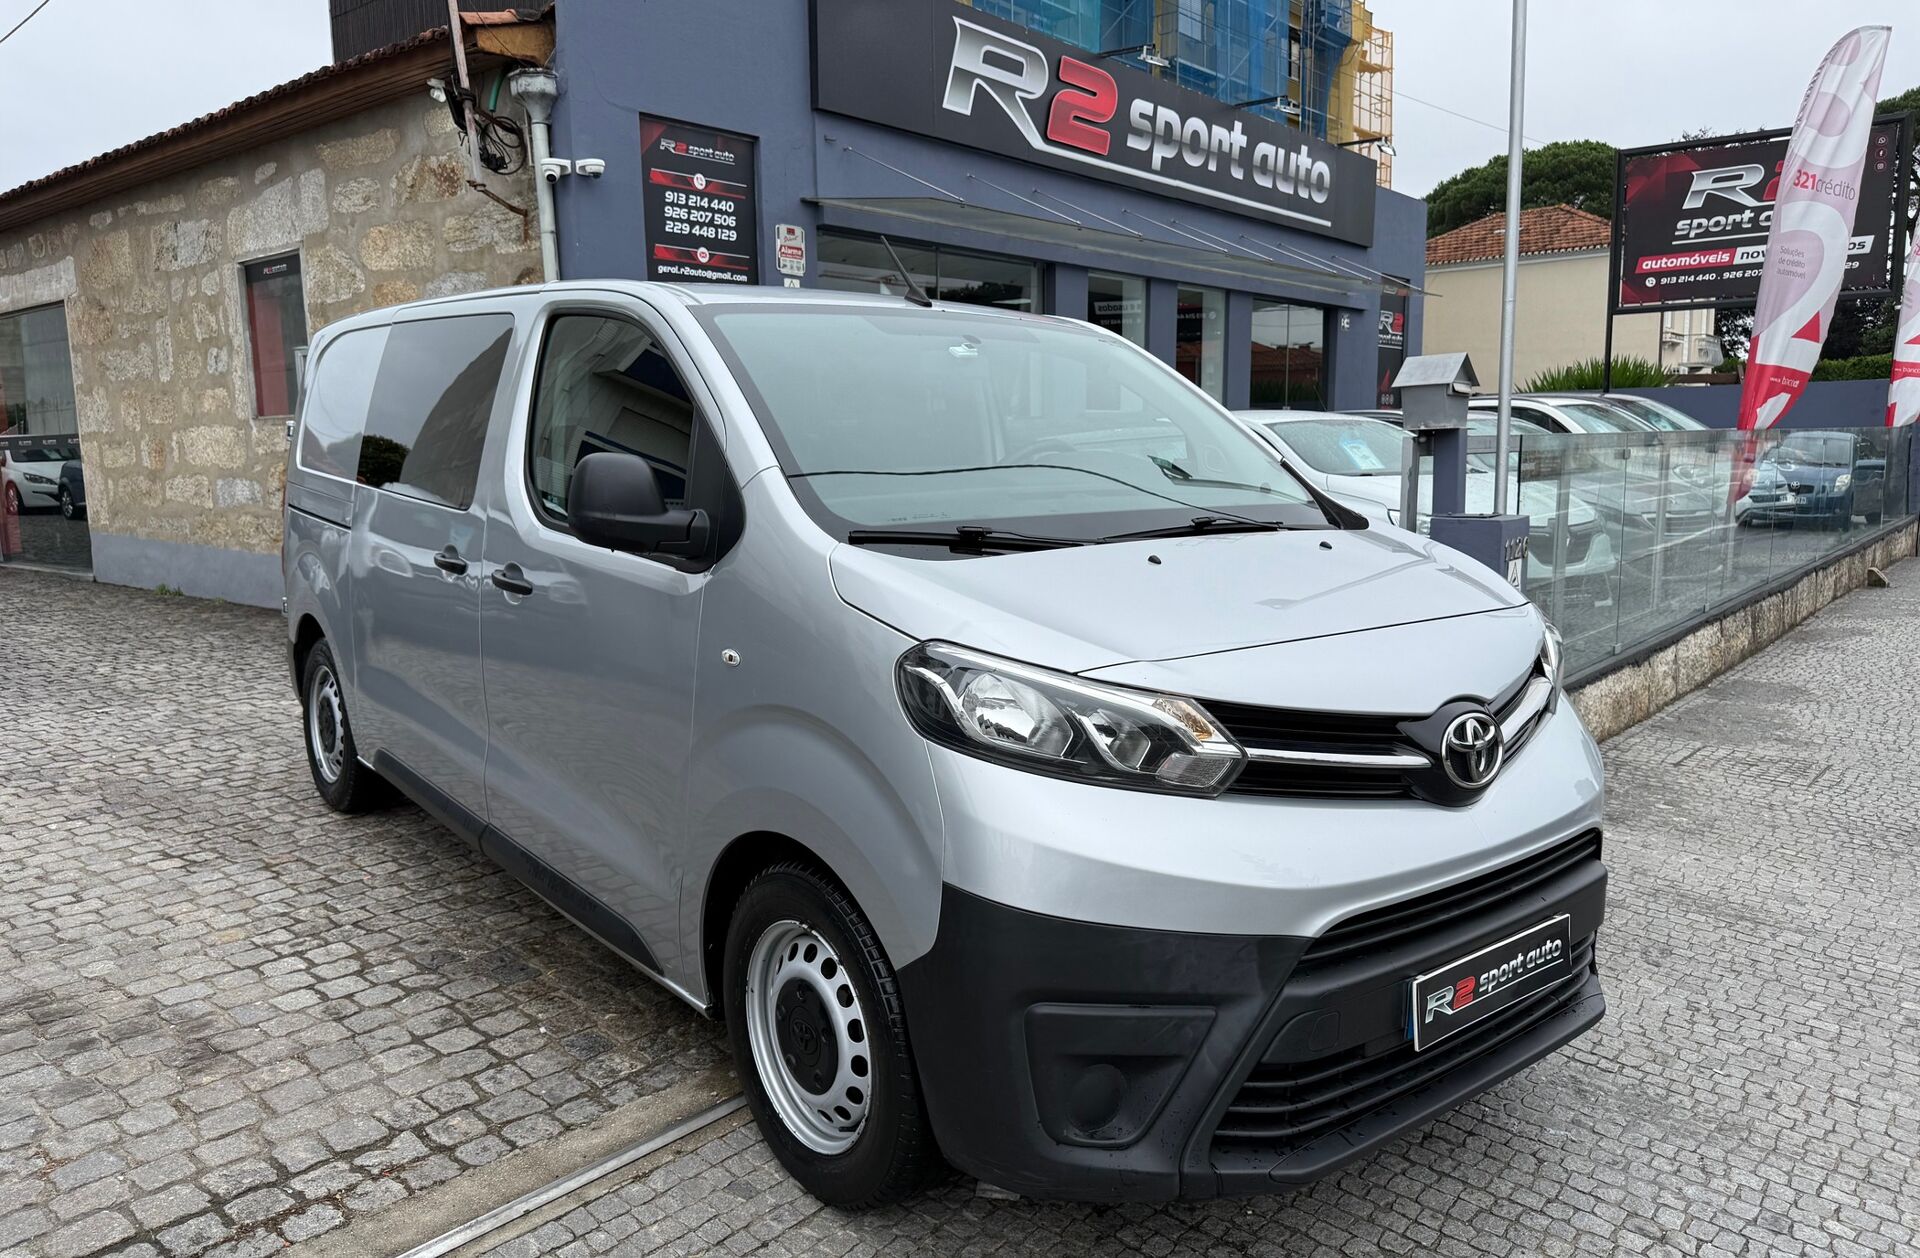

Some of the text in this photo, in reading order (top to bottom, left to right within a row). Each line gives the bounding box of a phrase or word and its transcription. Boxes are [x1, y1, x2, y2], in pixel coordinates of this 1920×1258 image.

[942, 16, 1332, 204] R2 sport auto
[660, 138, 735, 162] R2 sport auto
[665, 191, 735, 213] 913 214 440
[664, 206, 736, 227] 926 207 506
[1674, 209, 1755, 239] sport
[665, 221, 737, 241] 229 448 129
[1642, 251, 1730, 269] automóveis
[657, 265, 748, 282] geral.r2auto@gmail.com
[1660, 261, 1860, 285] 913 214 440 926 207 29
[1379, 310, 1404, 333] R2
[1425, 939, 1562, 1023] R2 sport auto
